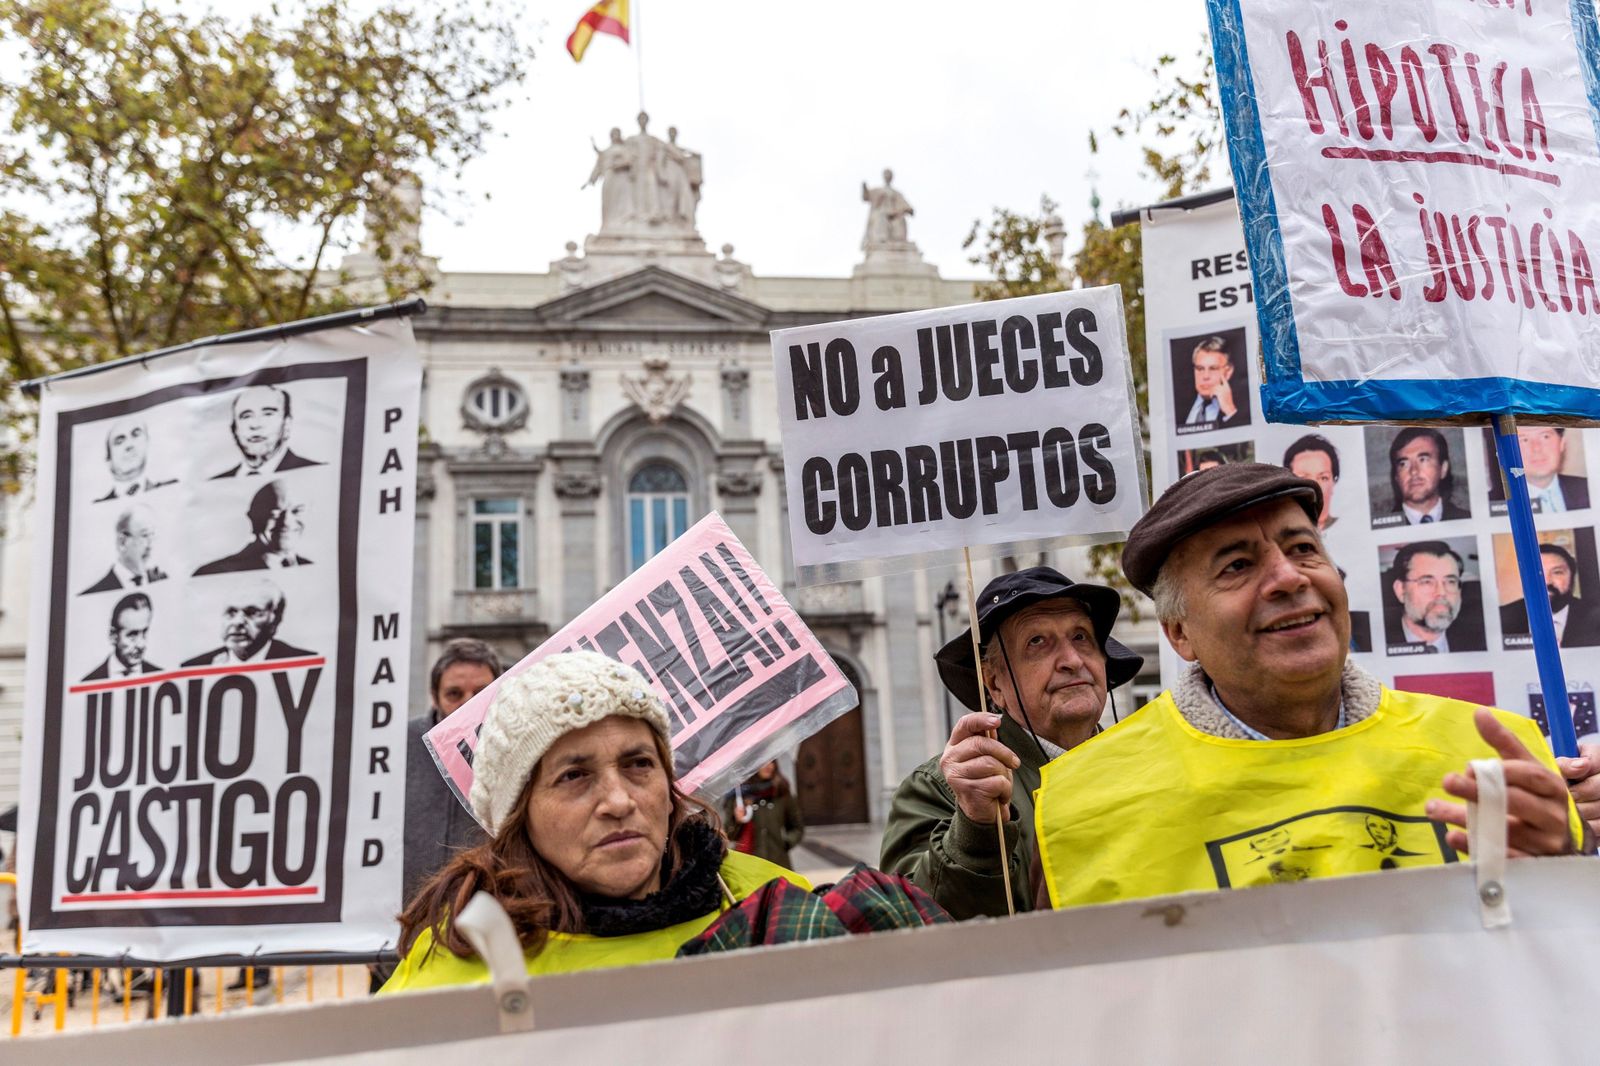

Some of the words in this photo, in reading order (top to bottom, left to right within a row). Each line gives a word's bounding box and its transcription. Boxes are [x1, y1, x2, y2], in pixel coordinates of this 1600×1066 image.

[1321, 203, 1402, 301] LA
[788, 337, 861, 421] NO
[871, 345, 907, 411] a
[916, 307, 1104, 406] JUECES
[378, 407, 404, 514] PAH
[801, 422, 1117, 536] CORRUPTOS
[74, 674, 257, 792] JUICIO
[271, 666, 323, 775] Y
[361, 611, 401, 868] MADRID
[65, 777, 321, 895] CASTIGO
